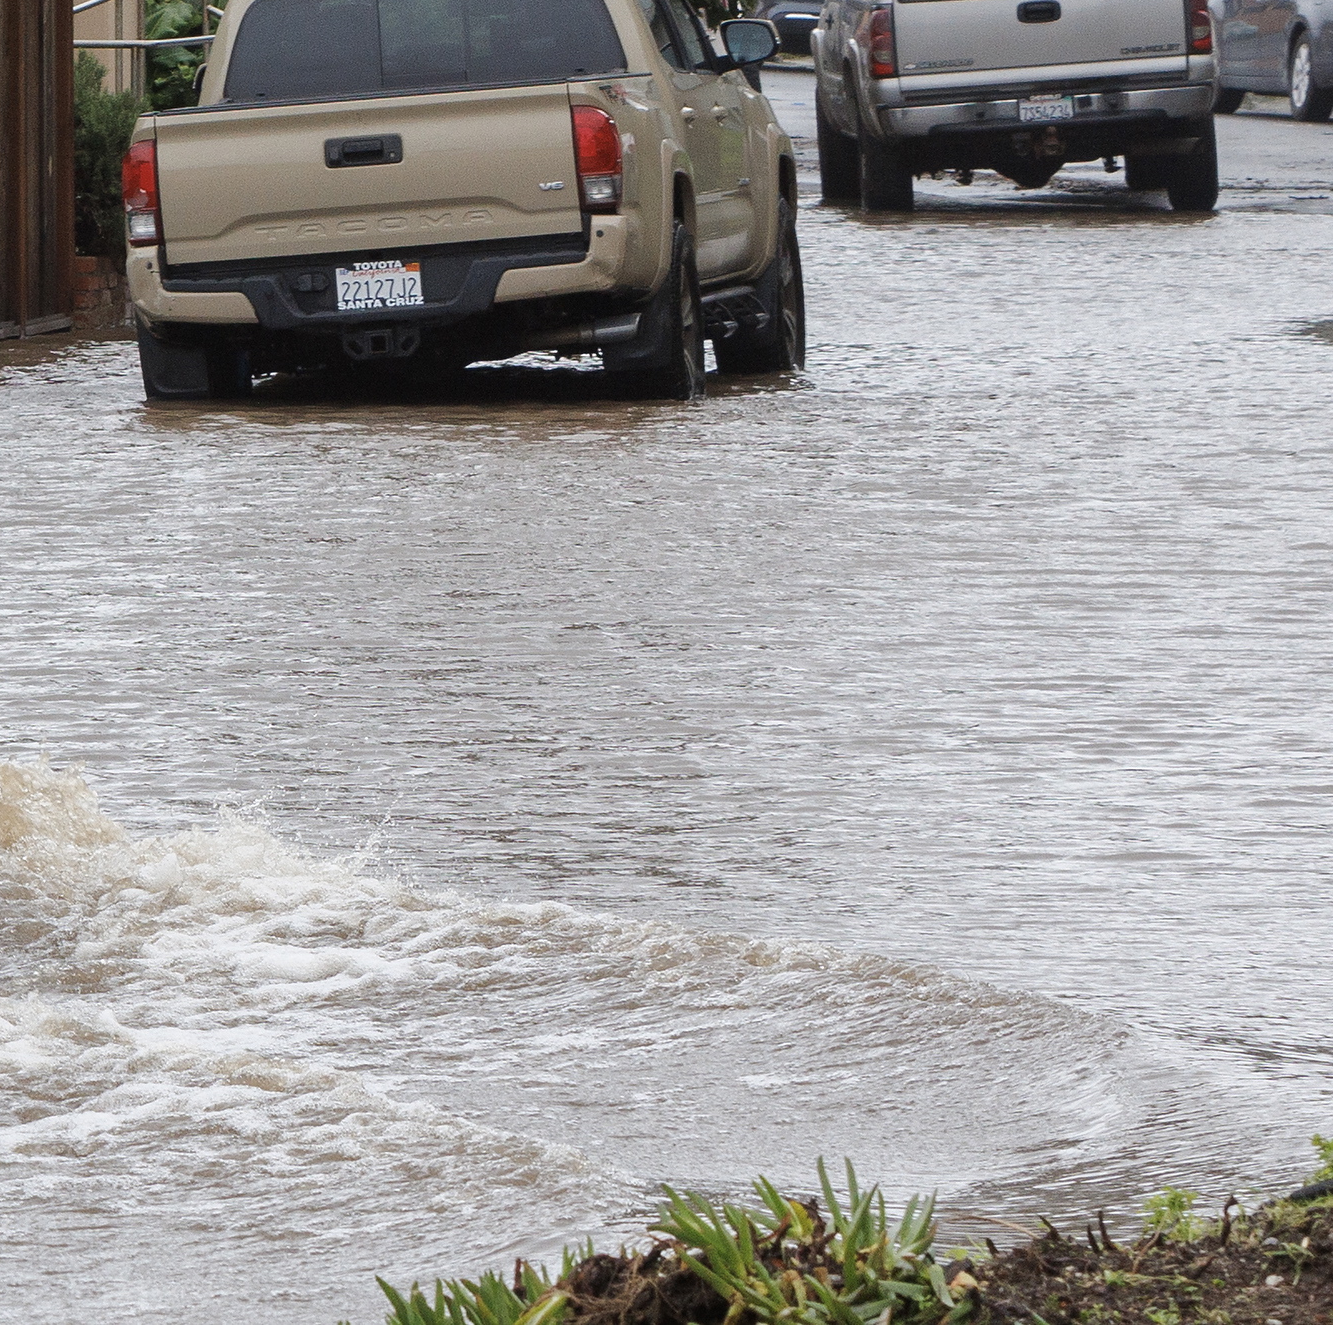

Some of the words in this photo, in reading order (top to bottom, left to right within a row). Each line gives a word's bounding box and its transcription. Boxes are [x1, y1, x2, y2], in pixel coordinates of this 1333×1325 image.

[538, 179, 564, 191] V6
[255, 209, 494, 241] TACOMA
[353, 260, 403, 271] TOYOTA
[341, 277, 418, 302] 22127J2
[337, 299, 383, 311] SANTA
[385, 296, 424, 307] CRUZ
